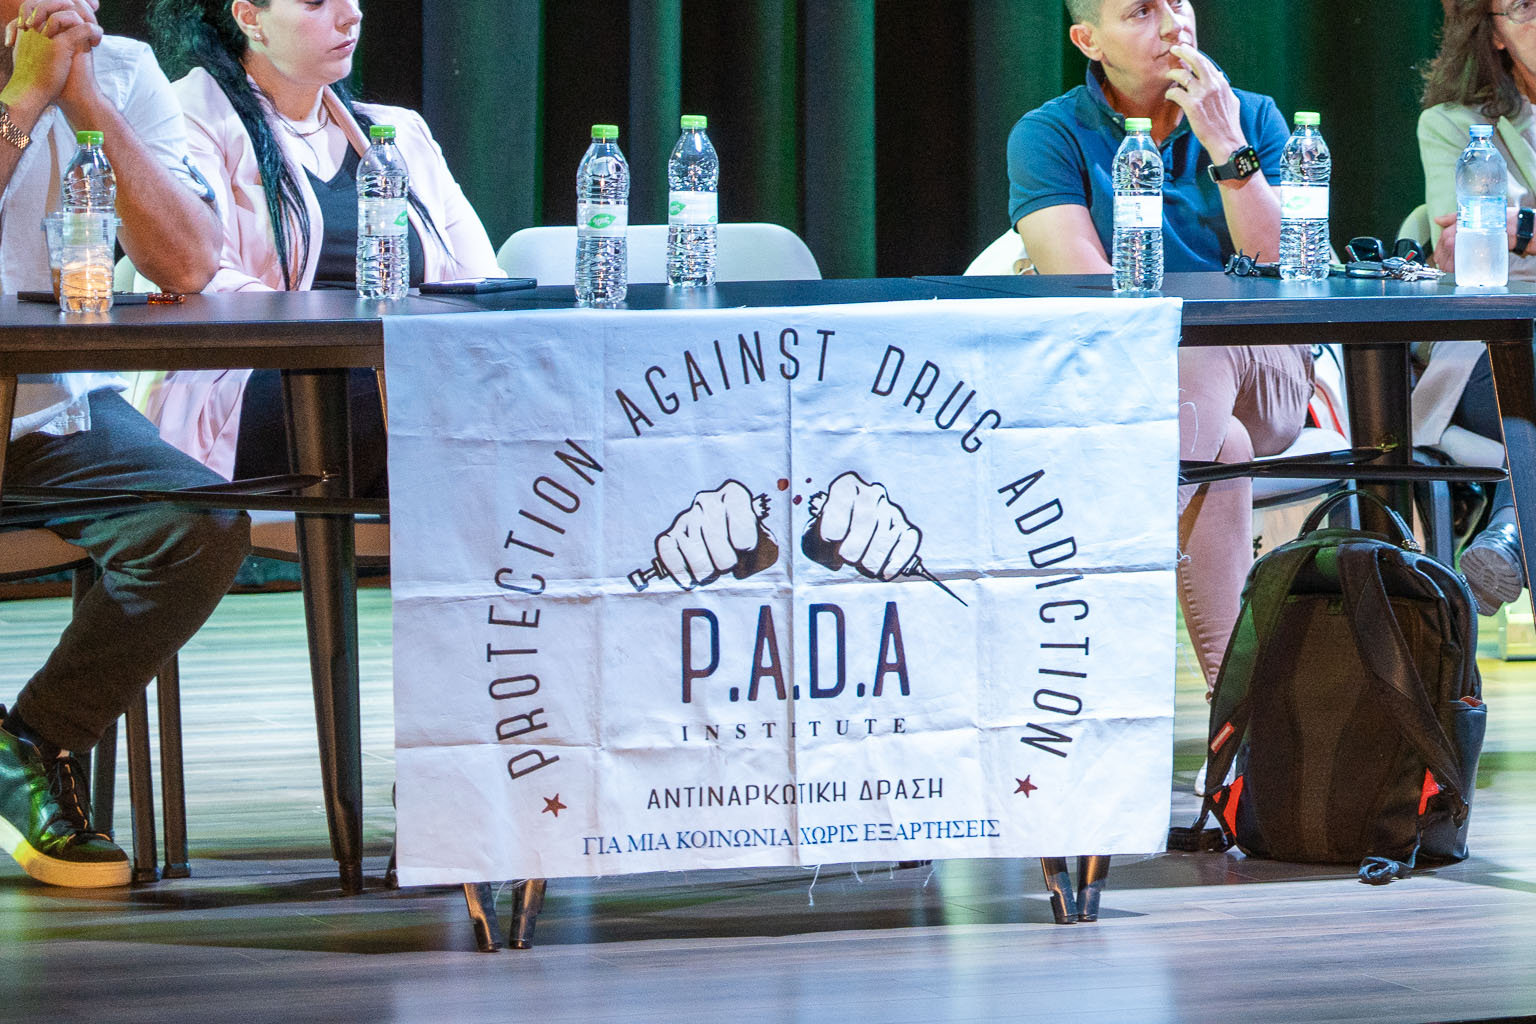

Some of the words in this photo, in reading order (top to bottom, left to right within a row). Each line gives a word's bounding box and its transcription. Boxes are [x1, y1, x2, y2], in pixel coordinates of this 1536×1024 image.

[486, 438, 605, 780] PROTECTION
[615, 327, 837, 437] AGAINST
[871, 343, 1002, 455] DRUG
[997, 468, 1092, 760] ADDICTION
[681, 601, 911, 704] P.A.D.A
[682, 717, 907, 742] INSTITUTE
[646, 780, 847, 810] ΑΝΤΙΝΑΡΚΩΤΙΚΗ
[859, 777, 944, 802] ΔΡΑΣΗ
[582, 836, 622, 856] ΓΙΑ
[627, 832, 671, 853] ΜΙΑ
[676, 828, 794, 850] ΚΟΙΝΩΝΙΑ
[799, 823, 859, 846] ΧΩΡΙΣ
[862, 818, 1001, 842] ΕΞΑΡΤΗΣΕΙΣ
